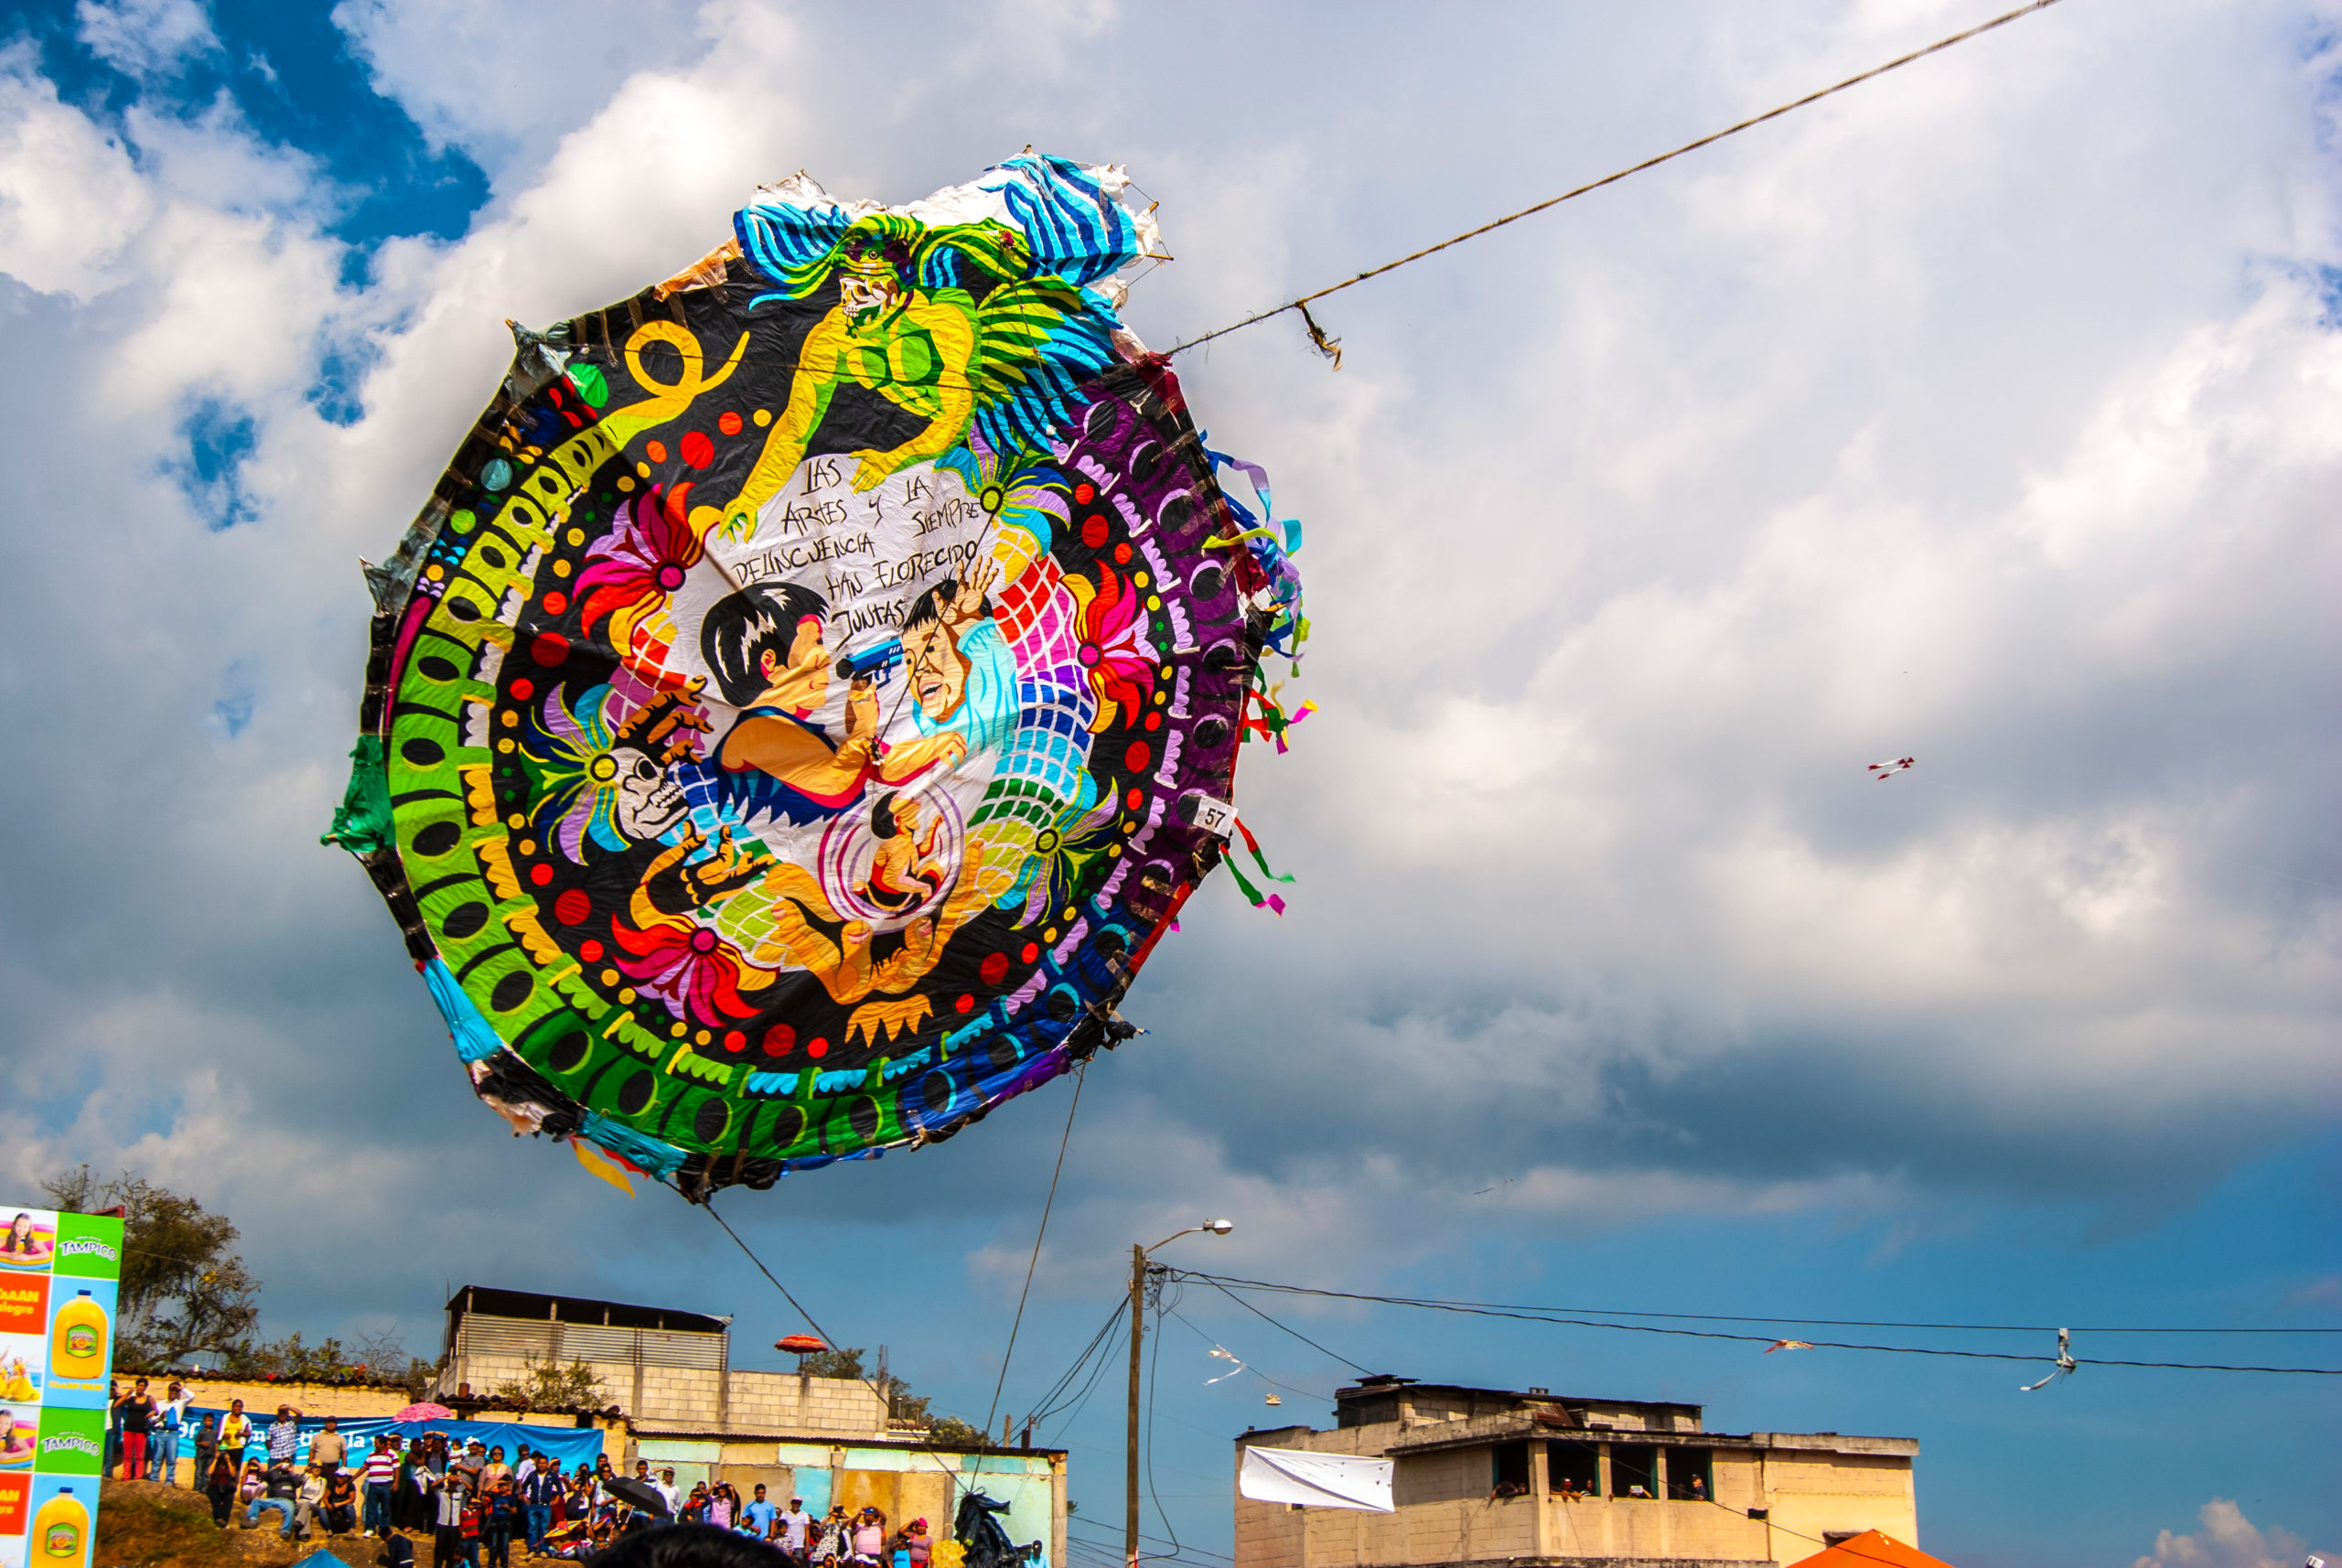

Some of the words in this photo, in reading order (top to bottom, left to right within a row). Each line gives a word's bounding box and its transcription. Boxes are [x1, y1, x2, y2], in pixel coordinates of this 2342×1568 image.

[800, 458, 842, 496] LAS
[781, 499, 848, 537] ARTES
[869, 494, 883, 528] Y
[902, 476, 935, 506] LA
[911, 498, 981, 538] SIEMPRE
[732, 532, 876, 585] DELINCUENCIA
[823, 571, 863, 602] HAN
[873, 540, 978, 589] FLORECIDO
[832, 599, 908, 651] JUNTAS
[1205, 808, 1226, 828] 57
[59, 1240, 117, 1261] TAMPICO
[40, 1436, 100, 1456] TAMPICO
